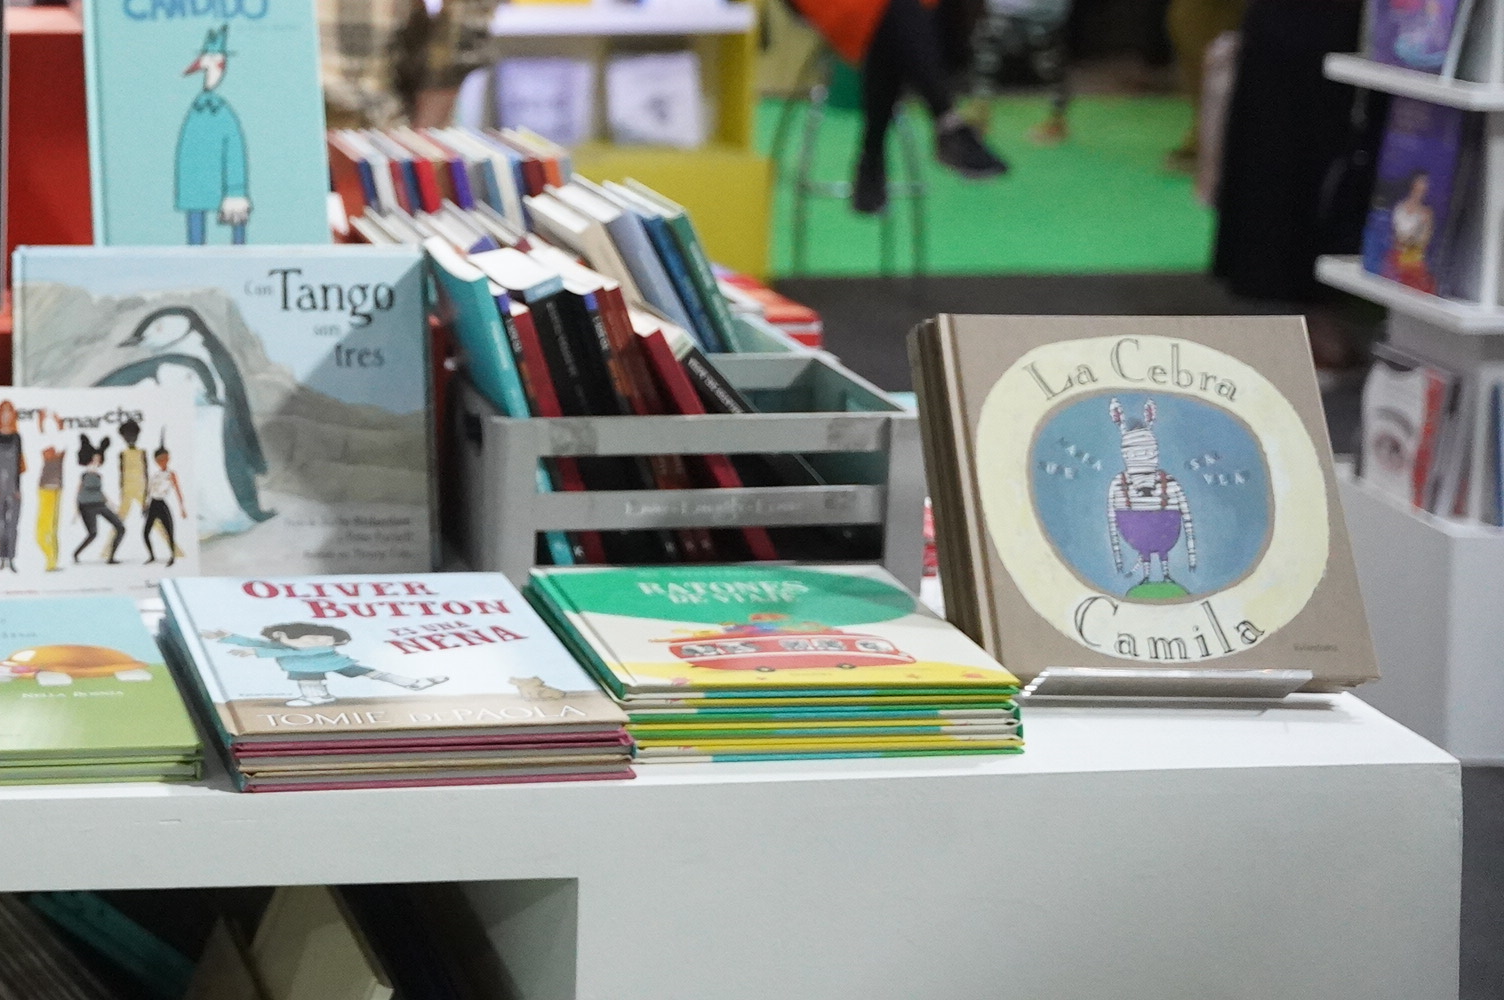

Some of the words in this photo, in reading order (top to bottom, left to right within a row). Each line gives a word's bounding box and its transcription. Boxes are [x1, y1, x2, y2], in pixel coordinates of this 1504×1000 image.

[267, 268, 396, 330] Tango
[334, 343, 386, 369] tres
[1022, 360, 1099, 401] La
[1109, 337, 1237, 402] Cebra
[241, 580, 440, 599] OLIVER
[301, 599, 510, 620] BUTTON
[384, 624, 529, 655] NENA
[1074, 595, 1266, 660] Camila
[255, 709, 391, 729] TOMIE
